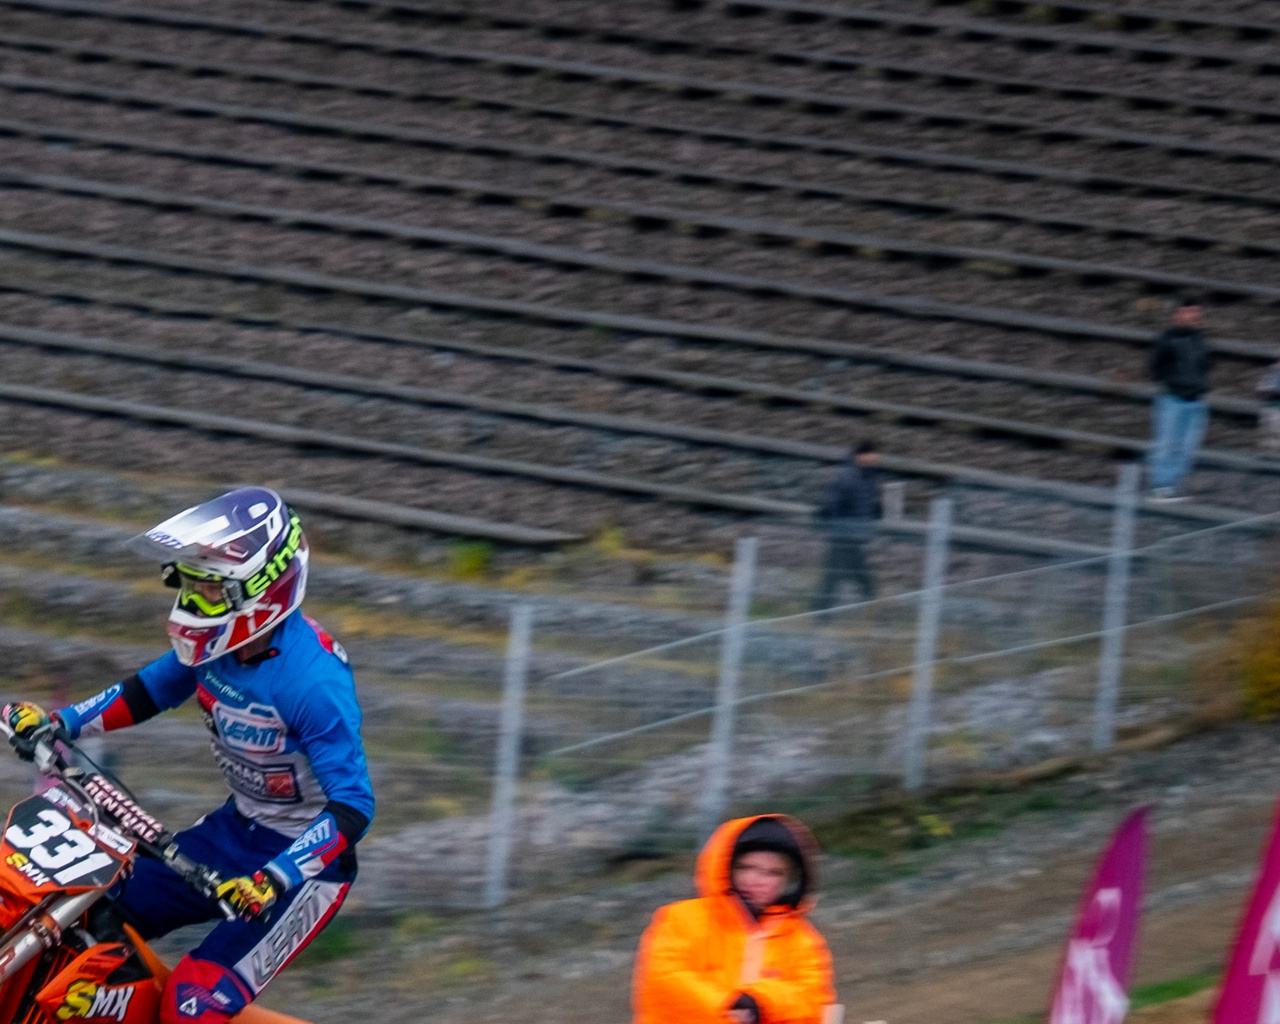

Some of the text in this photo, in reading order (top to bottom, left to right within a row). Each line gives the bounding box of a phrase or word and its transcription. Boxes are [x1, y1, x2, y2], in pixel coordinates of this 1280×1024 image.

[220, 718, 281, 748] LEATT
[5, 809, 114, 886] 331
[6, 852, 50, 887] SMX
[56, 980, 135, 1022] SMX
